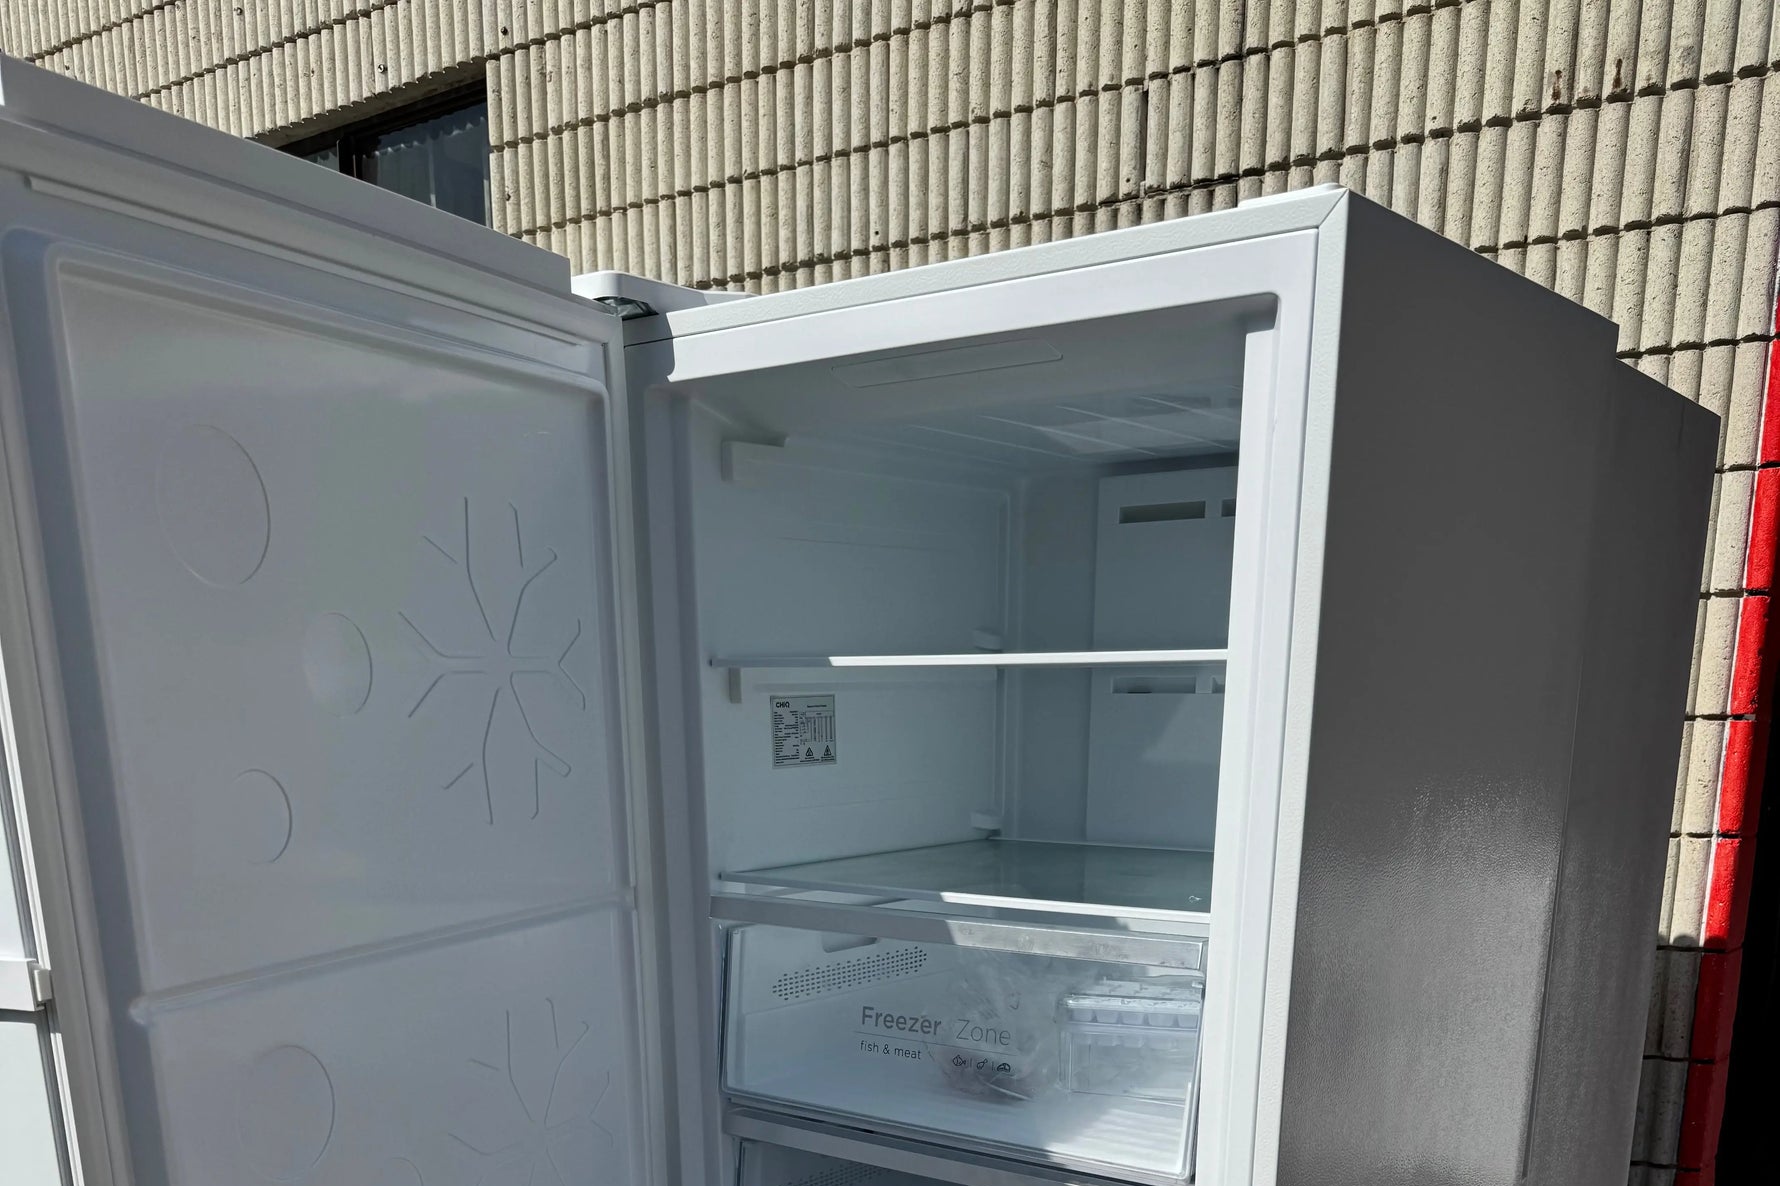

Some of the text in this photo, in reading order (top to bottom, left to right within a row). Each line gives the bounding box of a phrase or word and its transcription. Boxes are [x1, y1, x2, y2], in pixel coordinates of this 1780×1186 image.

[861, 1005, 1011, 1046] Freezer Zone
[860, 1040, 922, 1060] fish & meat
